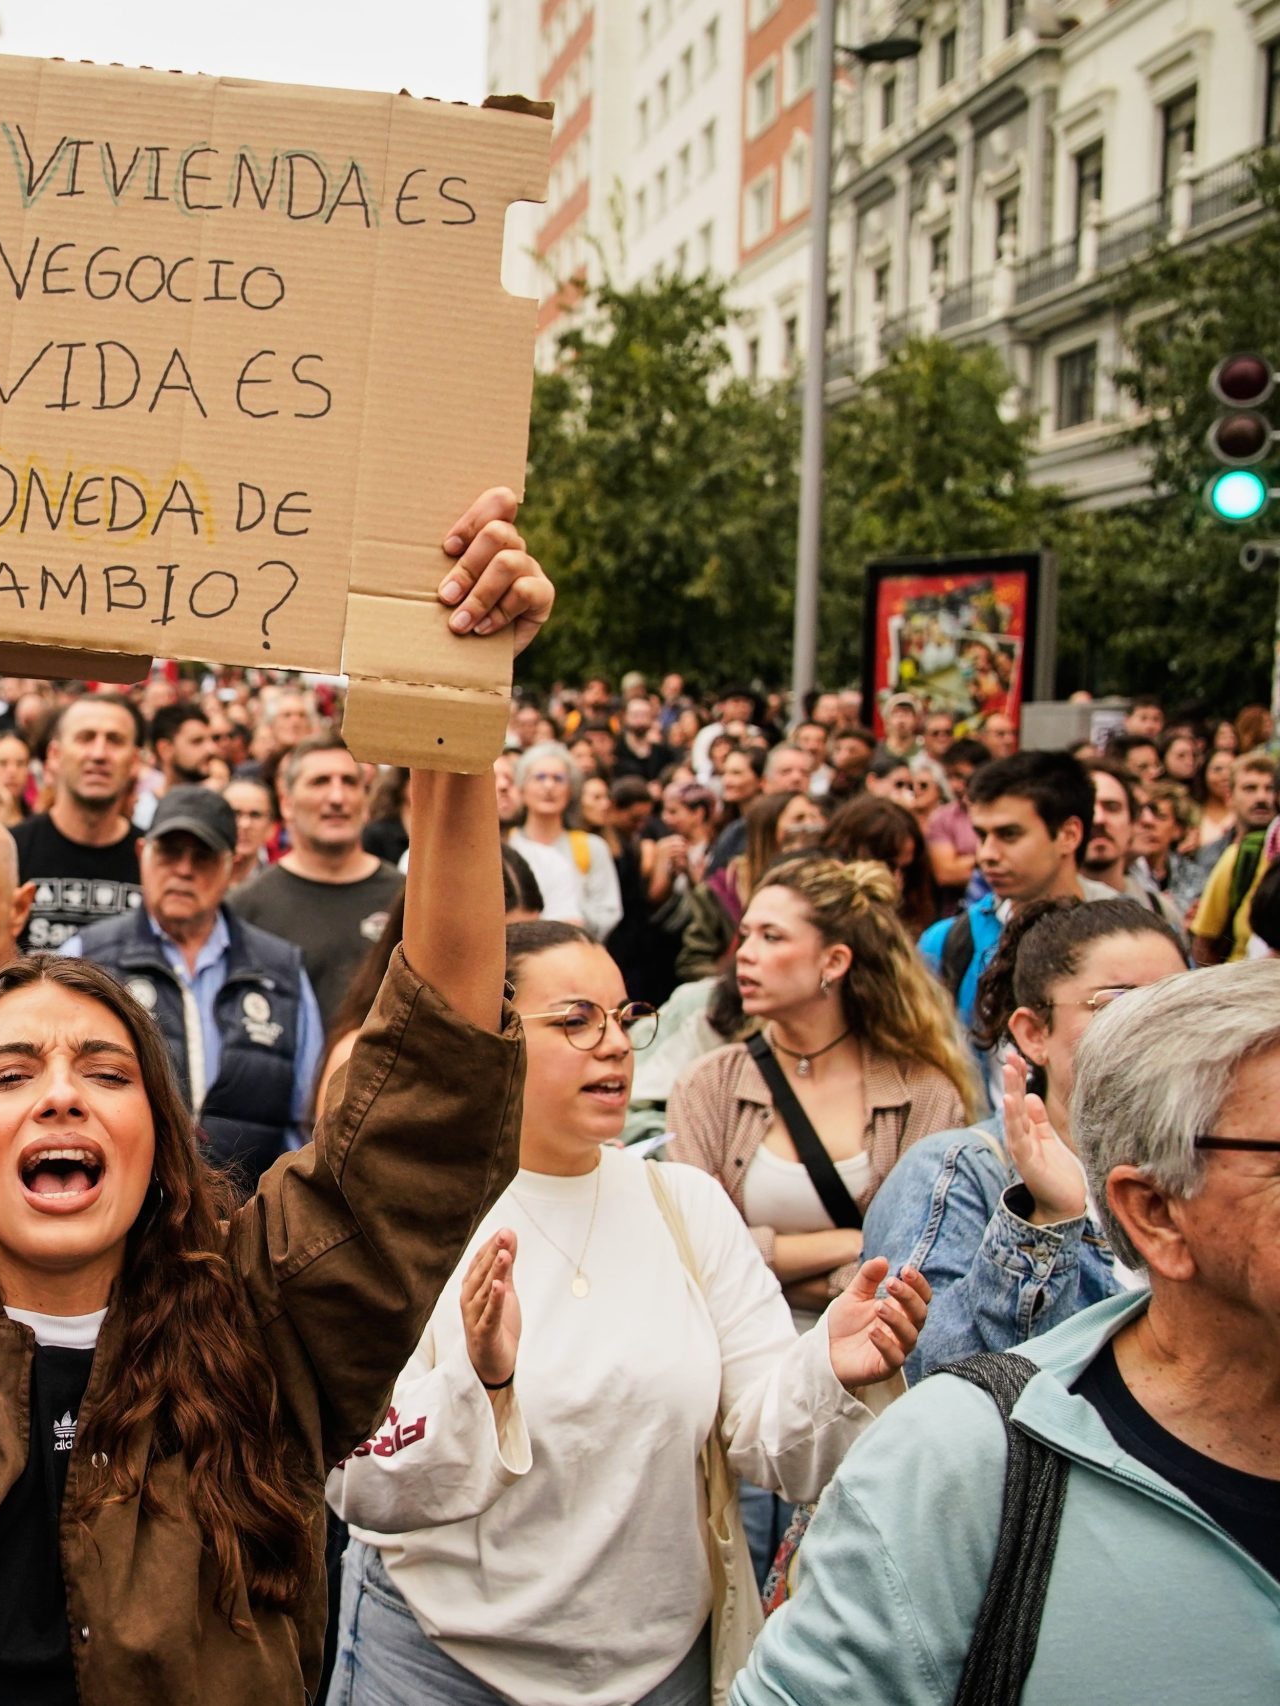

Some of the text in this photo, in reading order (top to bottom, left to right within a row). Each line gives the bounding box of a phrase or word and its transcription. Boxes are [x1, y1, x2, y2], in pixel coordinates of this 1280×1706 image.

[4, 123, 379, 229] VIVIENDA
[395, 168, 476, 226] ES
[235, 350, 332, 418] ES
[235, 482, 313, 537] DE
